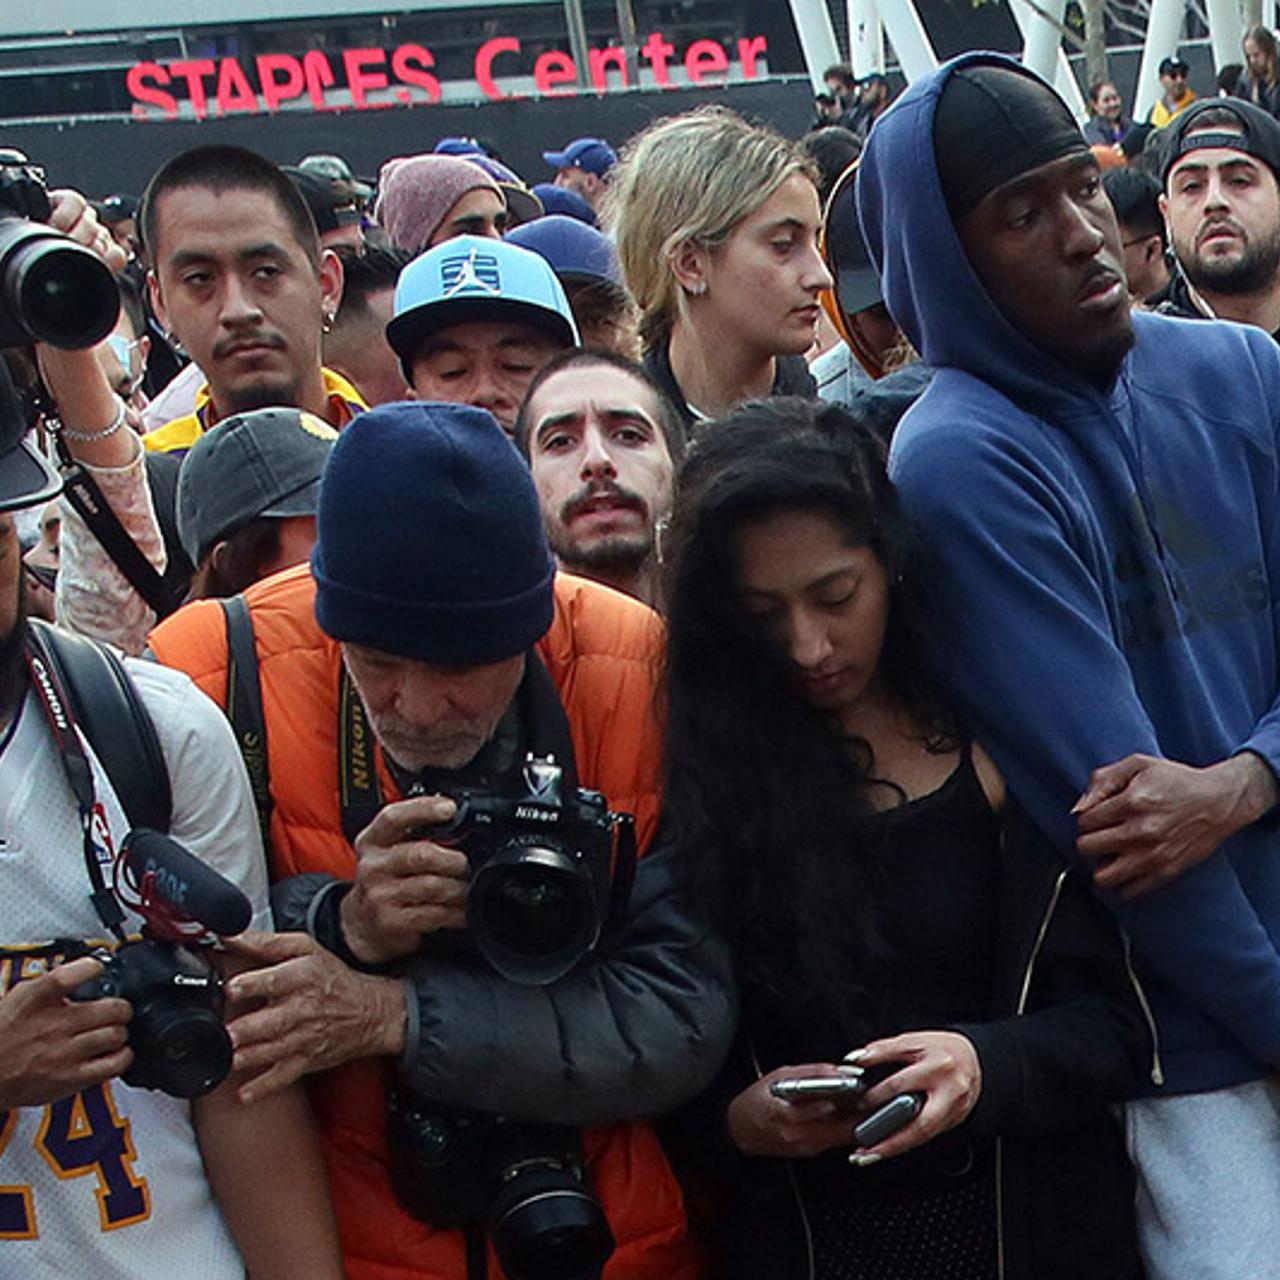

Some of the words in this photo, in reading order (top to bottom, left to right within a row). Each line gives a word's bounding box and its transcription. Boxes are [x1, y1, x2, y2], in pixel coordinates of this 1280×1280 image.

[127, 42, 441, 121] STAPLES
[475, 34, 767, 99] Center
[351, 704, 369, 791] Nikon
[514, 805, 559, 823] Nikon
[173, 972, 208, 988] Canon
[0, 1078, 151, 1240] 4
